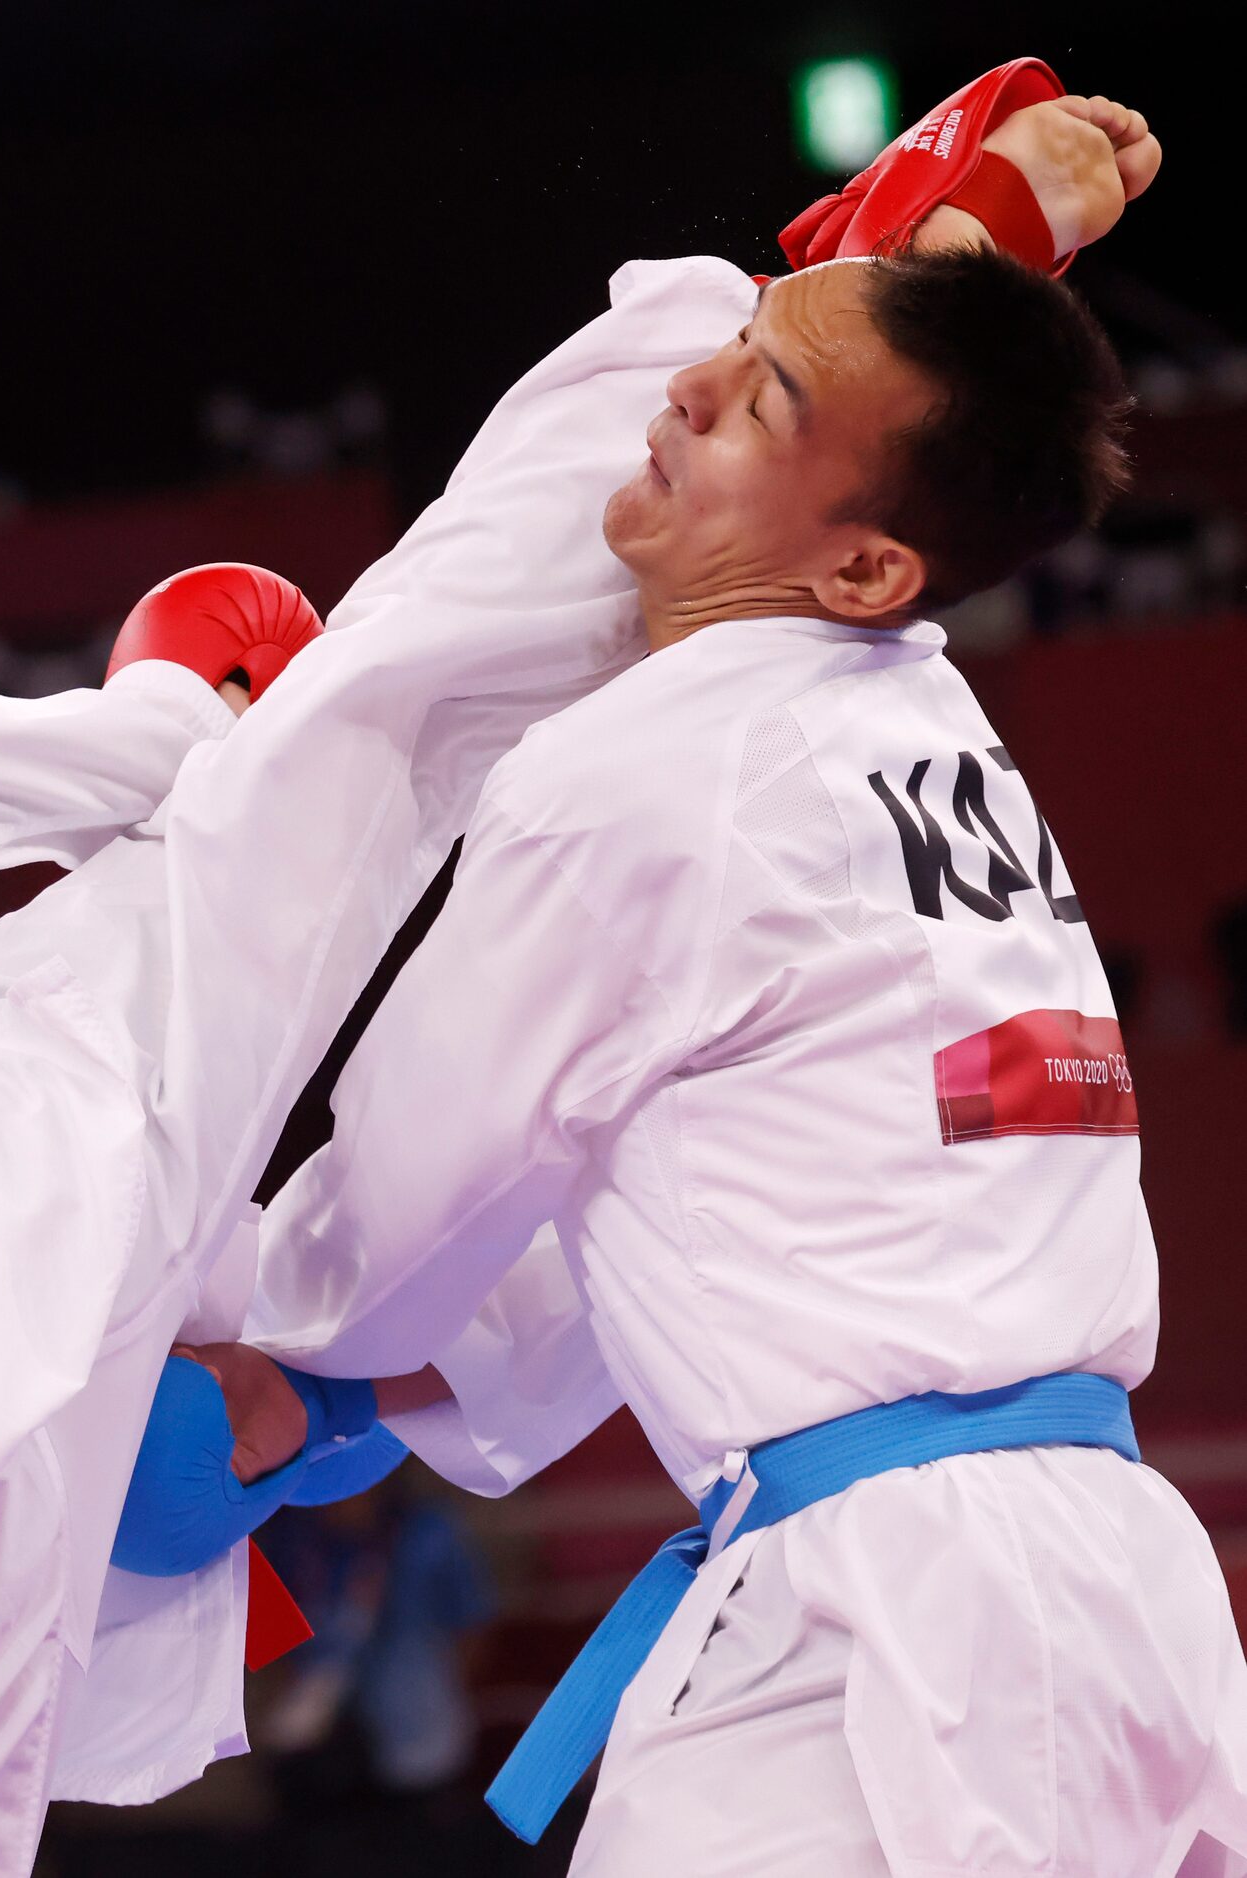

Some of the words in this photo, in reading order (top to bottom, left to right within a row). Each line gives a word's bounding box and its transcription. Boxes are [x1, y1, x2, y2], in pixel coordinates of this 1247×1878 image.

[933, 109, 964, 160] SHUREIDO
[1044, 1057, 1083, 1083] TOKYO
[1084, 1059, 1109, 1085] 2020
